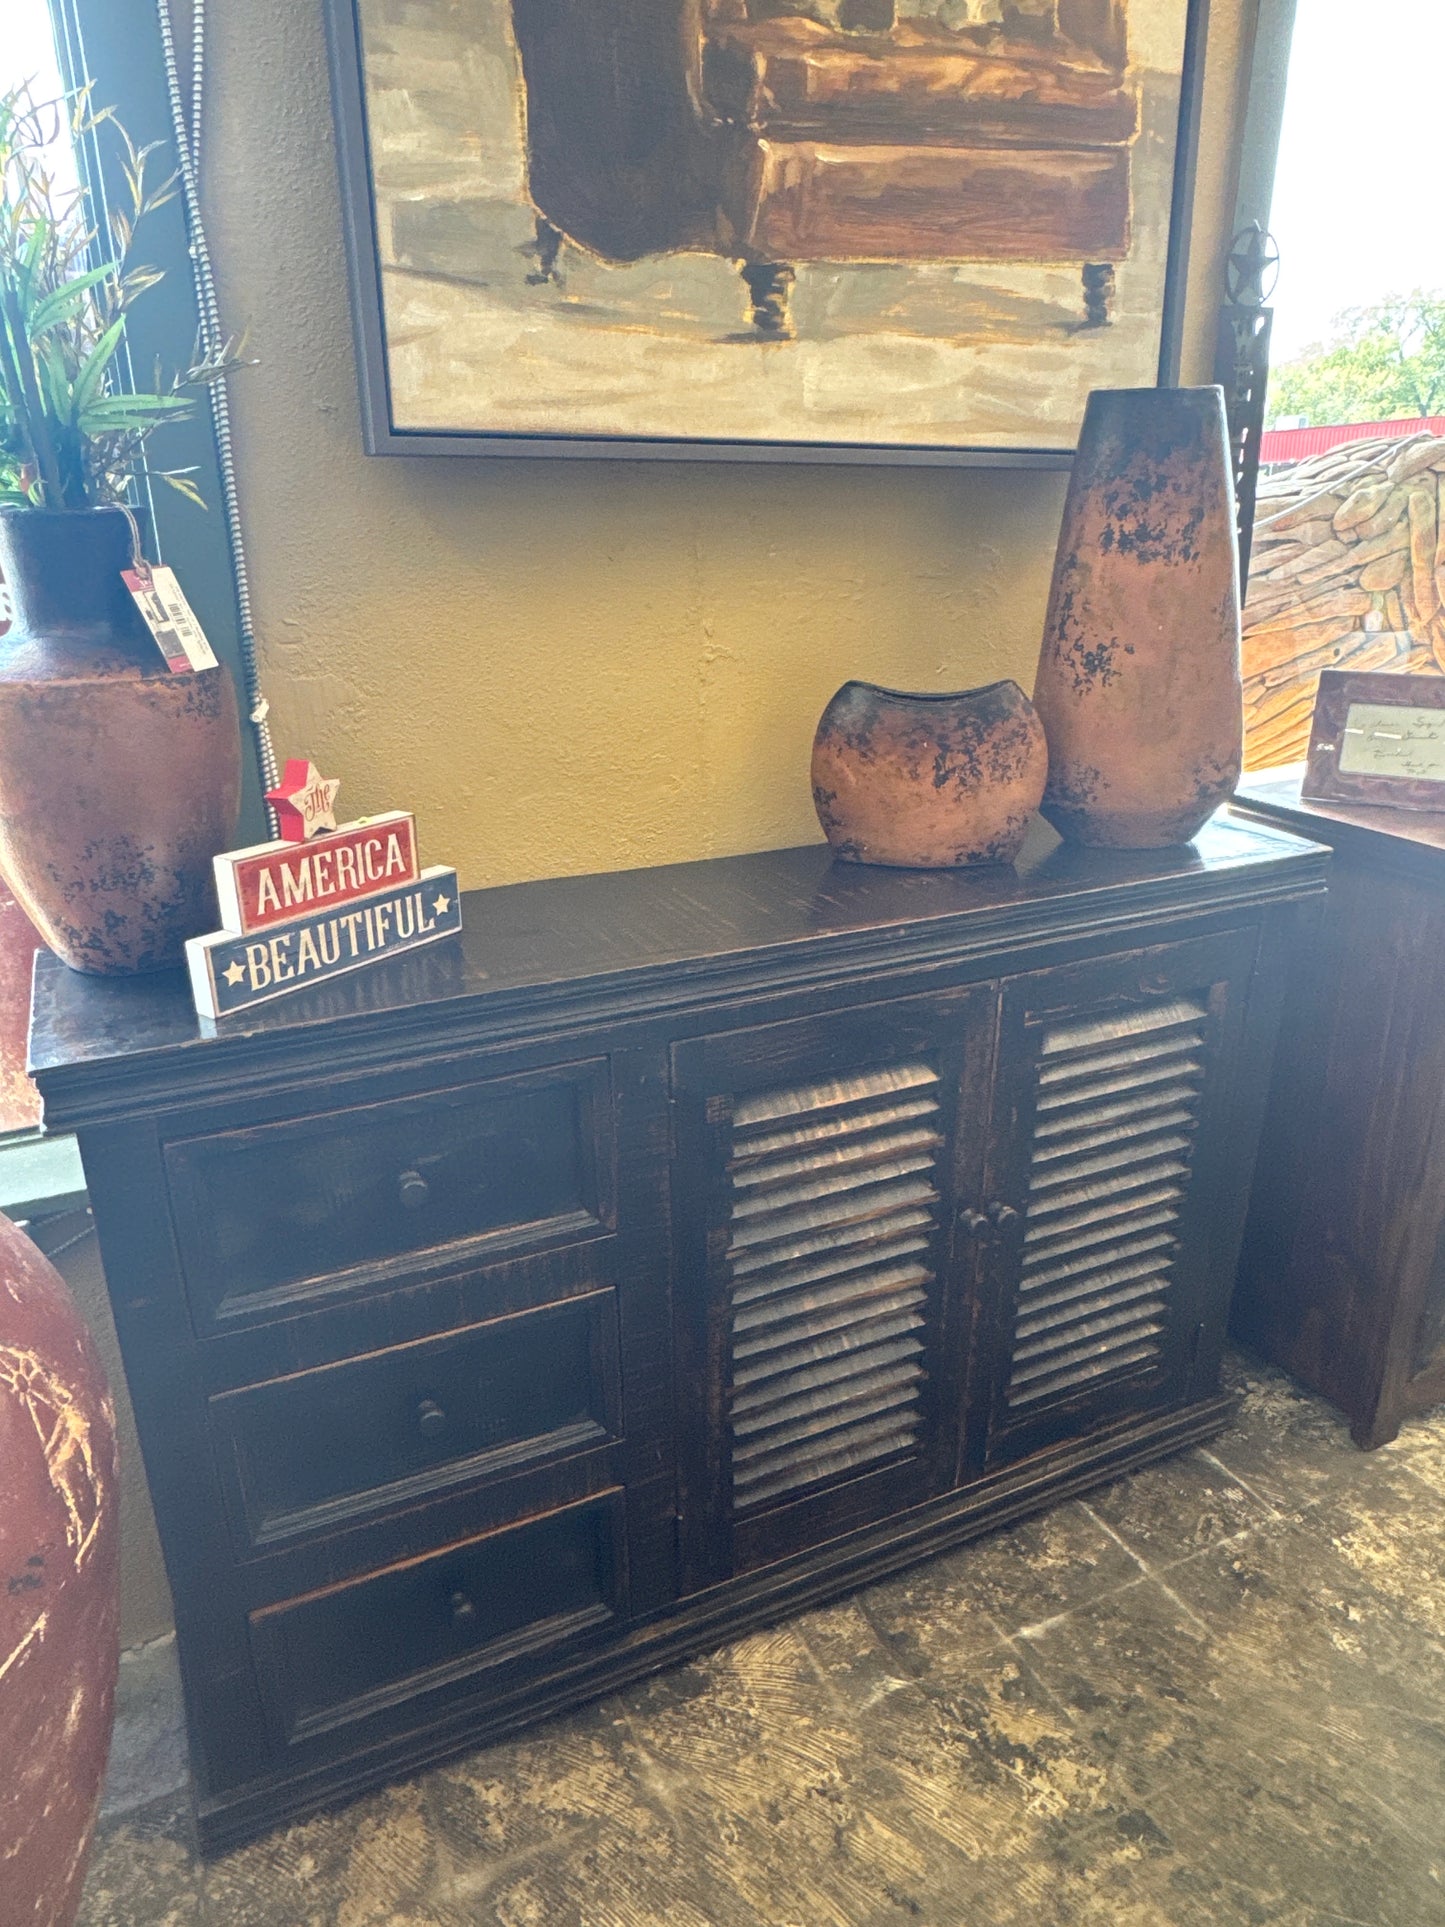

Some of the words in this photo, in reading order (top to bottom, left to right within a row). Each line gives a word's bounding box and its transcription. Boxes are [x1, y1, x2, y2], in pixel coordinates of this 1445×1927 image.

[304, 783, 331, 821] The
[256, 833, 406, 916] AMERICA
[245, 892, 436, 992] BEAUTIFUL
